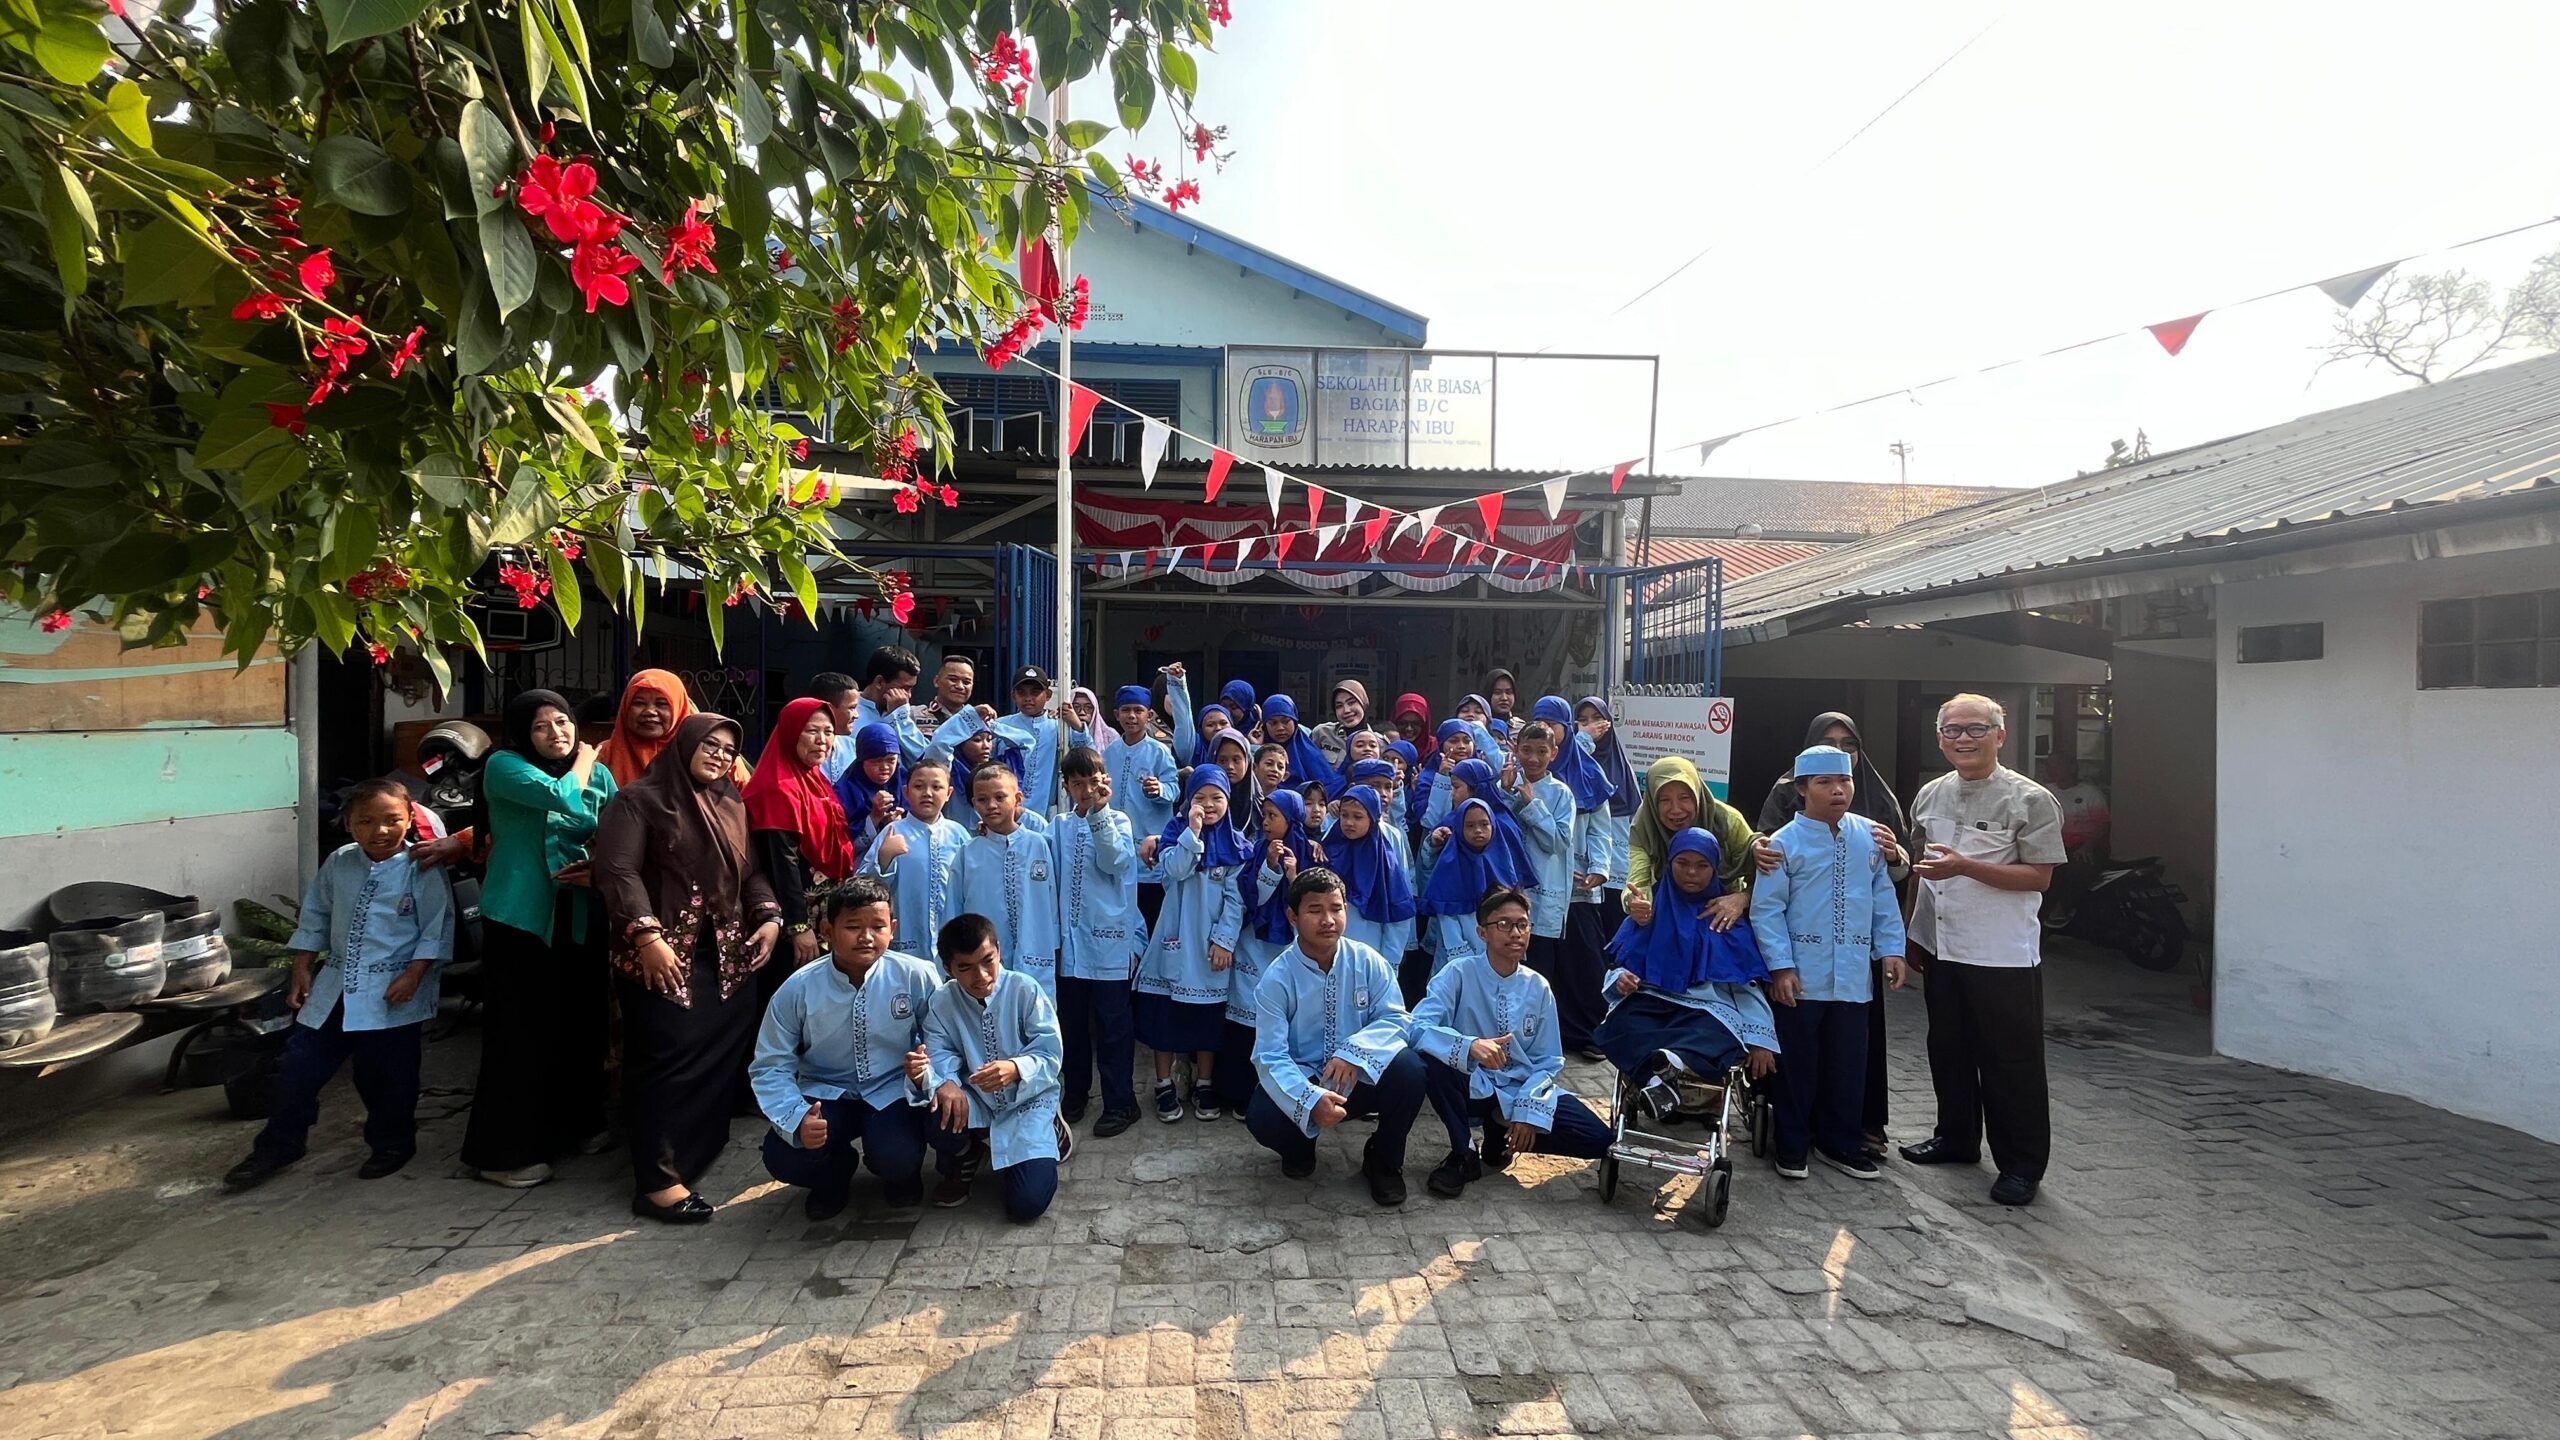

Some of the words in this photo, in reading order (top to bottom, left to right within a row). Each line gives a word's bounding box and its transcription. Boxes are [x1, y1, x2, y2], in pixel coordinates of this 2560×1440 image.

[1317, 375, 1387, 392] SEKOLAH
[1438, 378, 1482, 395] BIASA
[1417, 398, 1449, 416] B/C
[1343, 418, 1420, 434] HARAPAN
[1426, 420, 1455, 435] IBU
[1249, 434, 1283, 443] HARAPAN
[1285, 435, 1298, 443] IBU
[1624, 719, 1640, 727] ANDA
[1642, 720, 1674, 728] MEMASUKI
[1675, 722, 1707, 731] KAWASAN
[1632, 731, 1663, 740] DILARANG
[1664, 733, 1696, 742] MEROKOK
